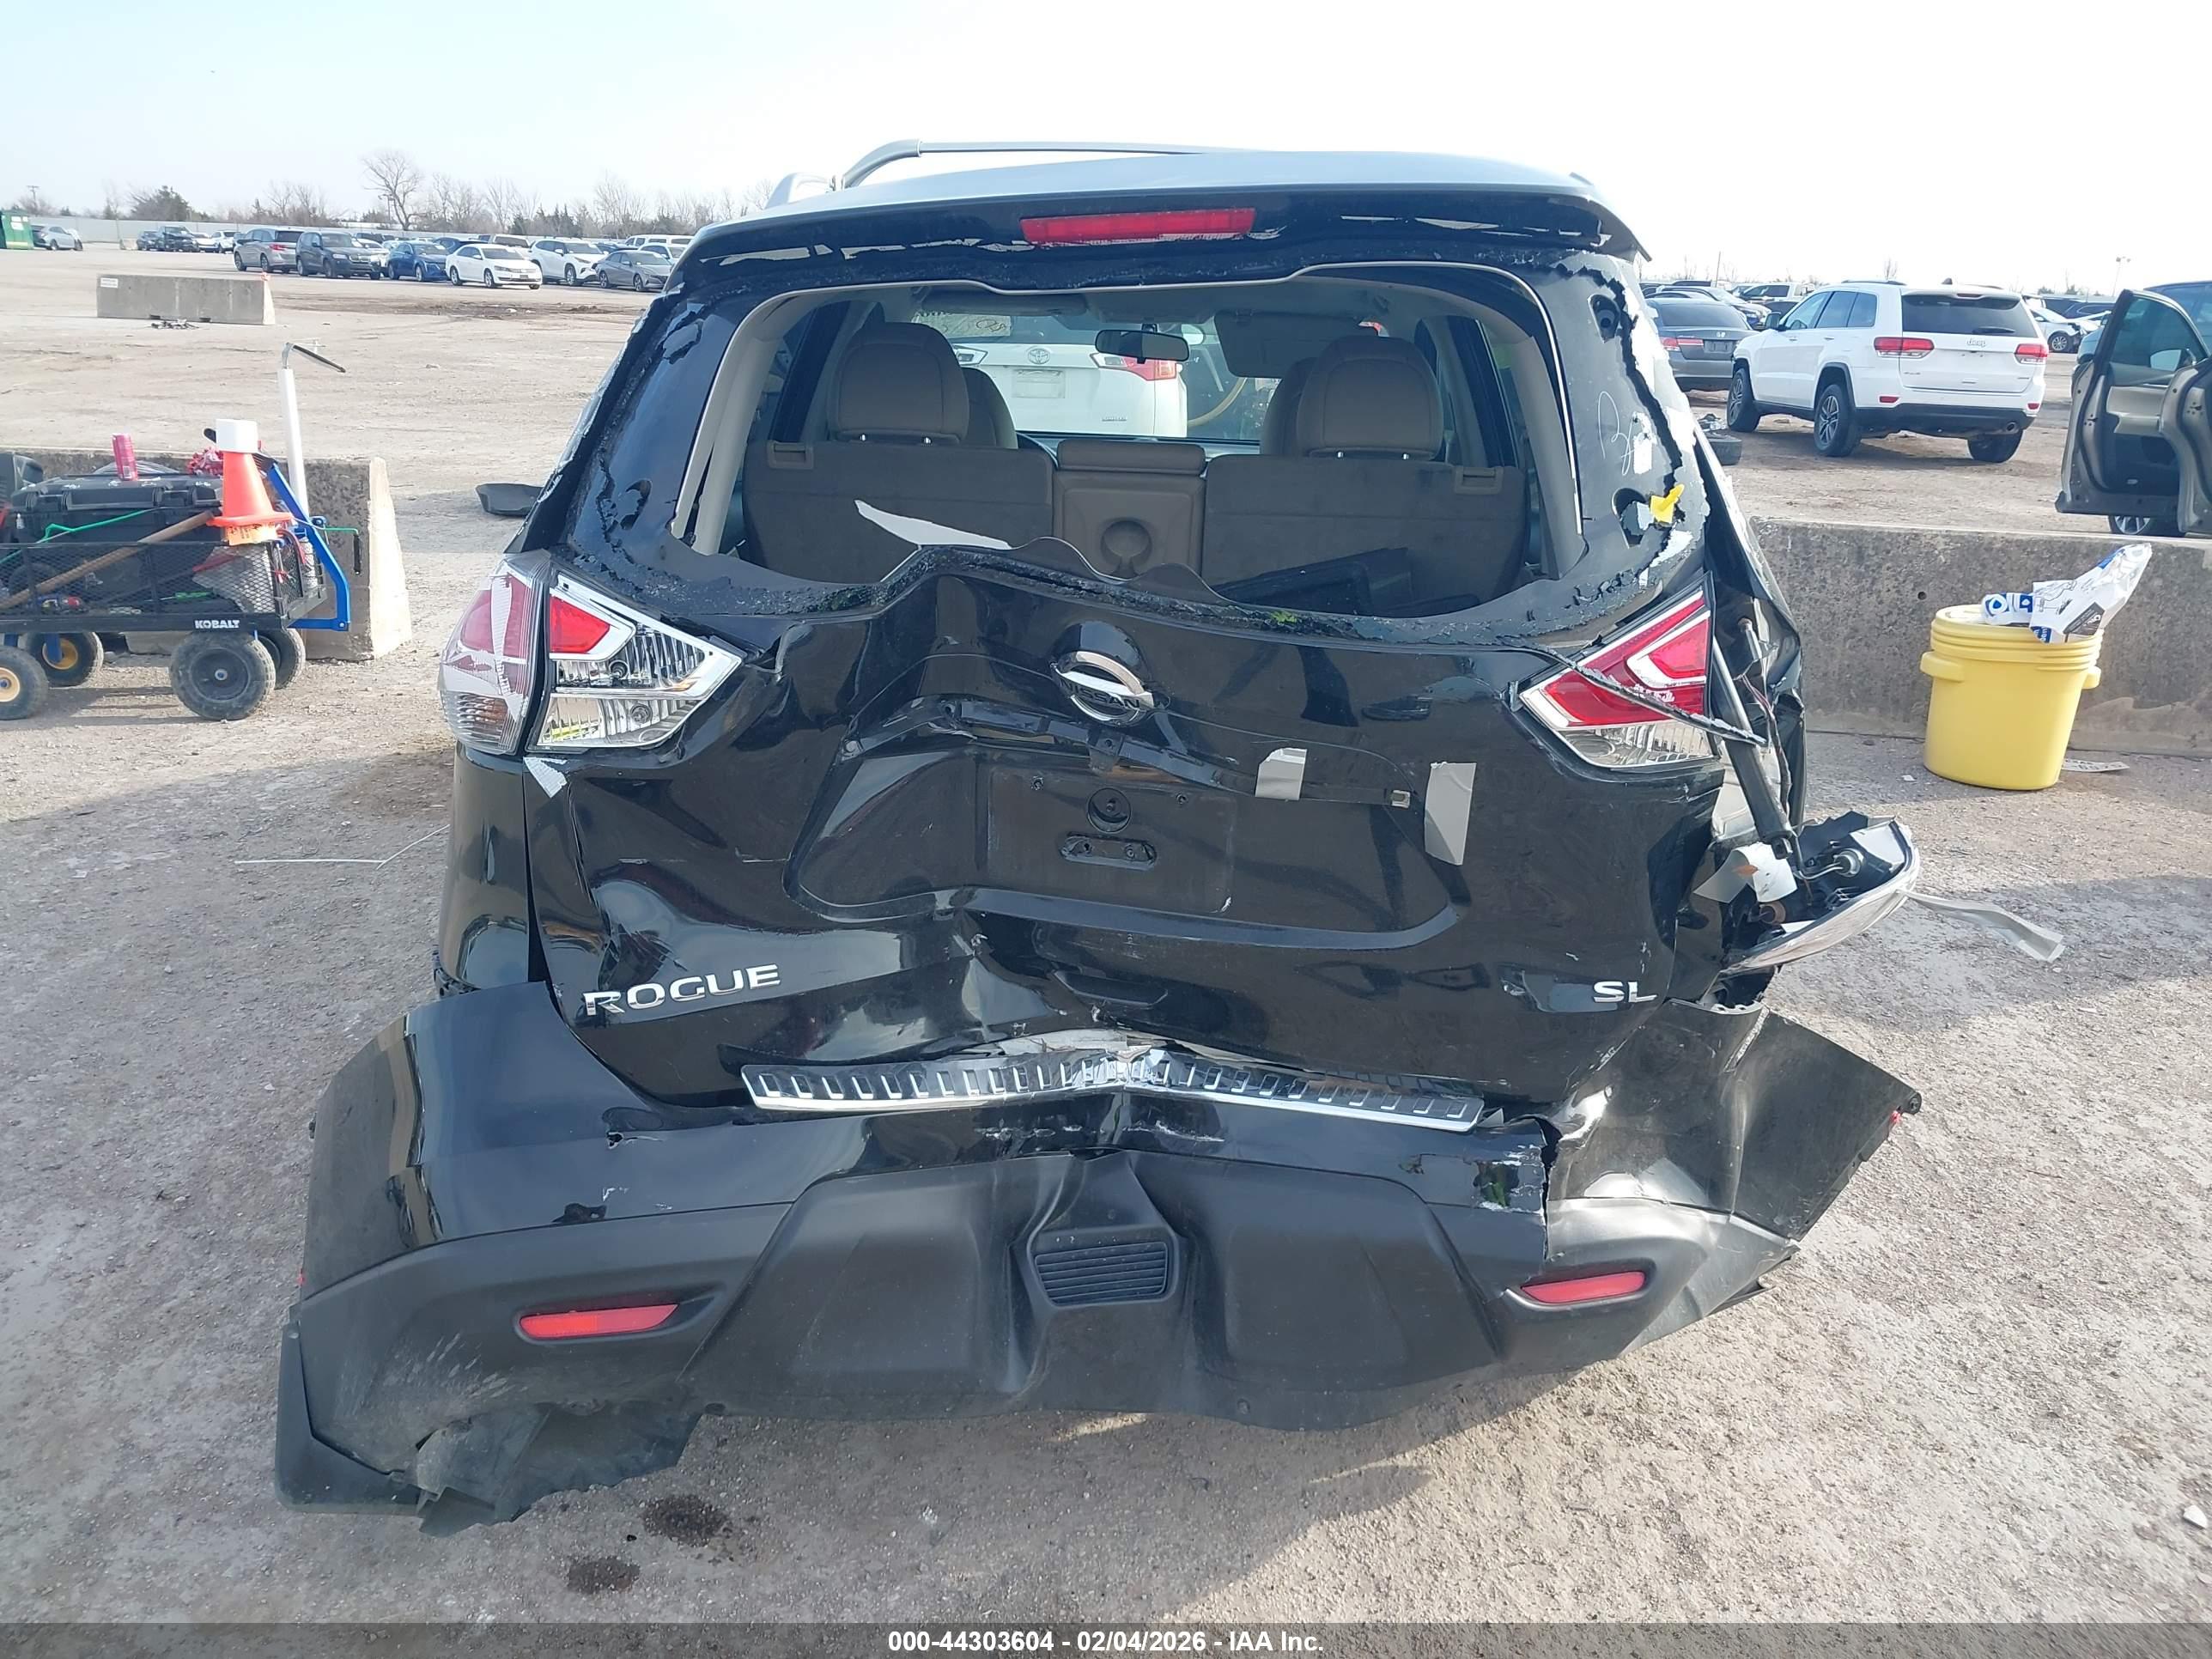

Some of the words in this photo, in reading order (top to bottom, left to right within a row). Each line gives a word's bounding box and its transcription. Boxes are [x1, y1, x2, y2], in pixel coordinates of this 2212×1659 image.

[194, 619, 240, 629] KOBALT
[1059, 678, 1140, 708] NISSAN
[582, 963, 781, 1016] ROGUE
[1593, 981, 1658, 1003] SL
